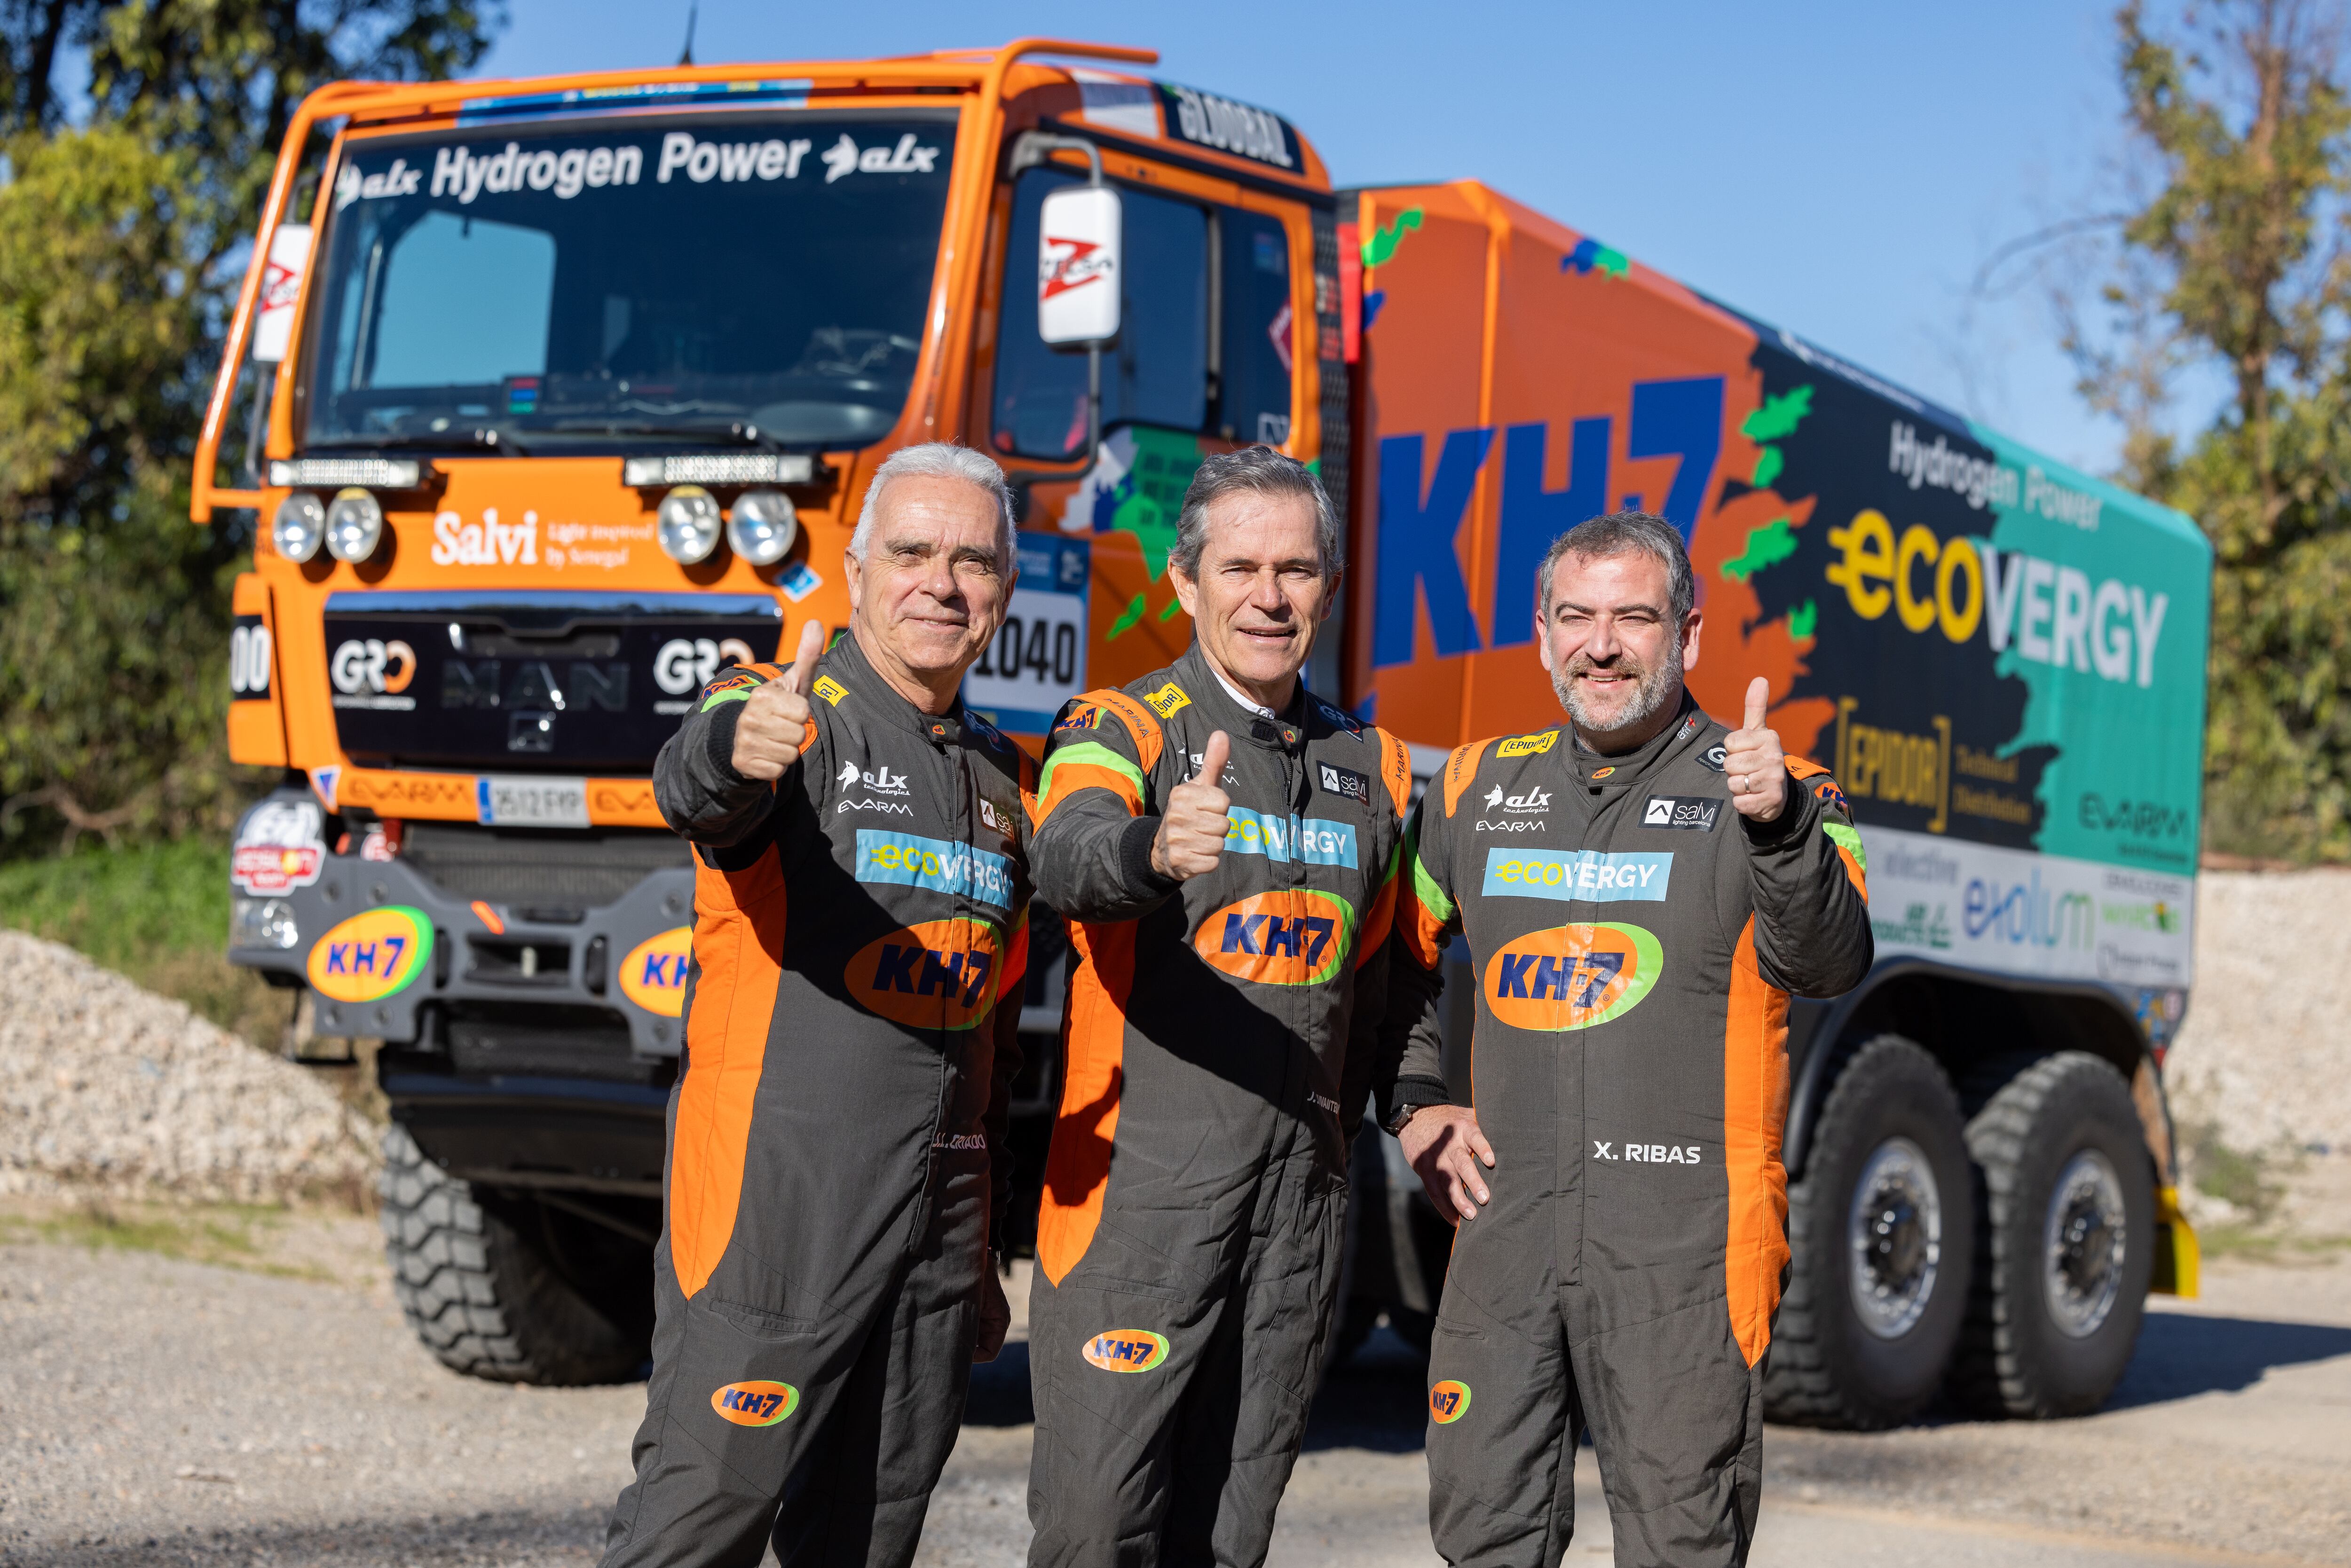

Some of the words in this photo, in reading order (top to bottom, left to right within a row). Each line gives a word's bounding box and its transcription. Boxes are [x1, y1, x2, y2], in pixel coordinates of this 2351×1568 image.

[430, 142, 643, 204] Hydrogen
[657, 131, 812, 183] Power
[859, 133, 939, 173] alx
[1889, 420, 2018, 509] Hydrogen
[2026, 465, 2103, 531] Power
[431, 506, 538, 565] Salvi
[1825, 508, 2169, 689] ecoVERGY
[863, 766, 908, 788] alx
[863, 783, 911, 796] technologies
[595, 787, 657, 812] EVA
[838, 798, 914, 817] EVARM
[1506, 786, 1553, 807] alx
[1675, 802, 1717, 821] salvi
[1475, 820, 1545, 832] EVARM
[1495, 860, 1658, 889] ecoVERGY
[1221, 913, 1335, 967] KH-7
[1497, 952, 1625, 1008] KH-7
[1594, 1141, 1618, 1160] X.
[1625, 1144, 1701, 1164] RIBAS
[1093, 1338, 1154, 1365] KH-7
[721, 1388, 784, 1418] KH-7
[1433, 1390, 1460, 1415] KH-7
